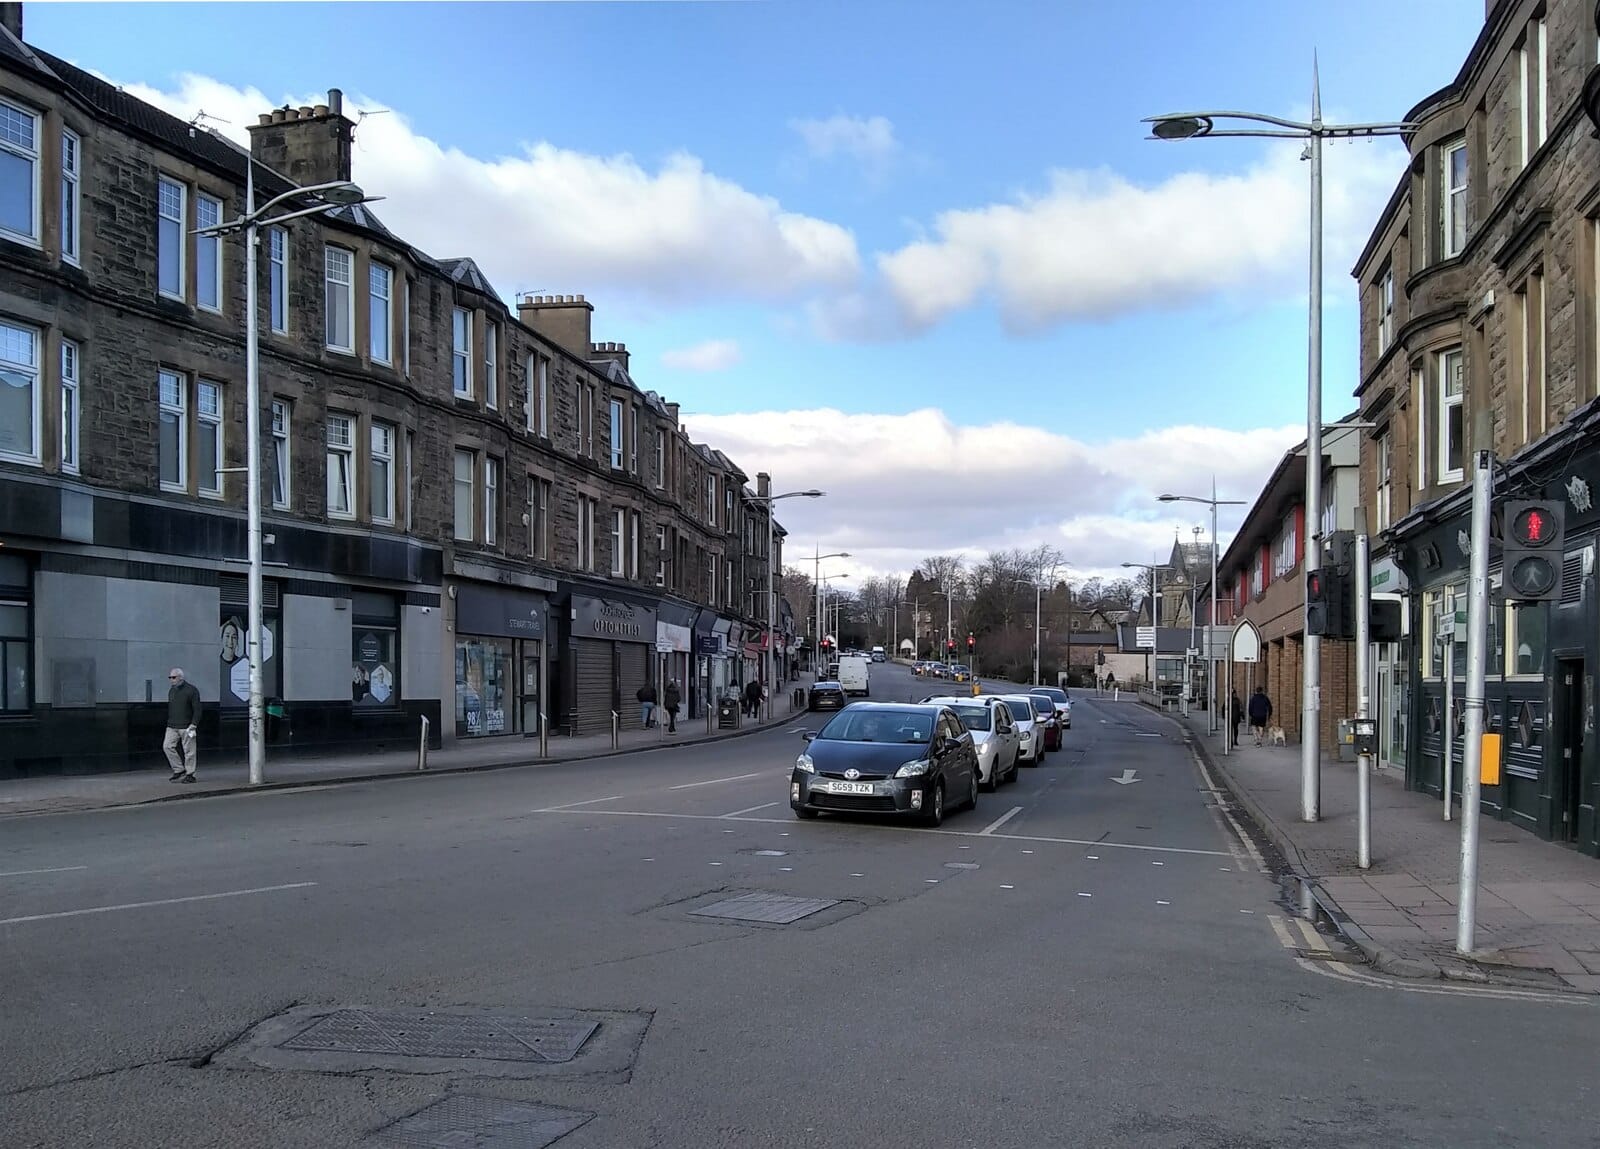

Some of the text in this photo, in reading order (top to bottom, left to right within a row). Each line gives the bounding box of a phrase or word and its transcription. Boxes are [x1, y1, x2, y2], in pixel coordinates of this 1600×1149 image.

[593, 618, 641, 637] OPTOMETRIST
[832, 782, 870, 793] SG59 TZK
